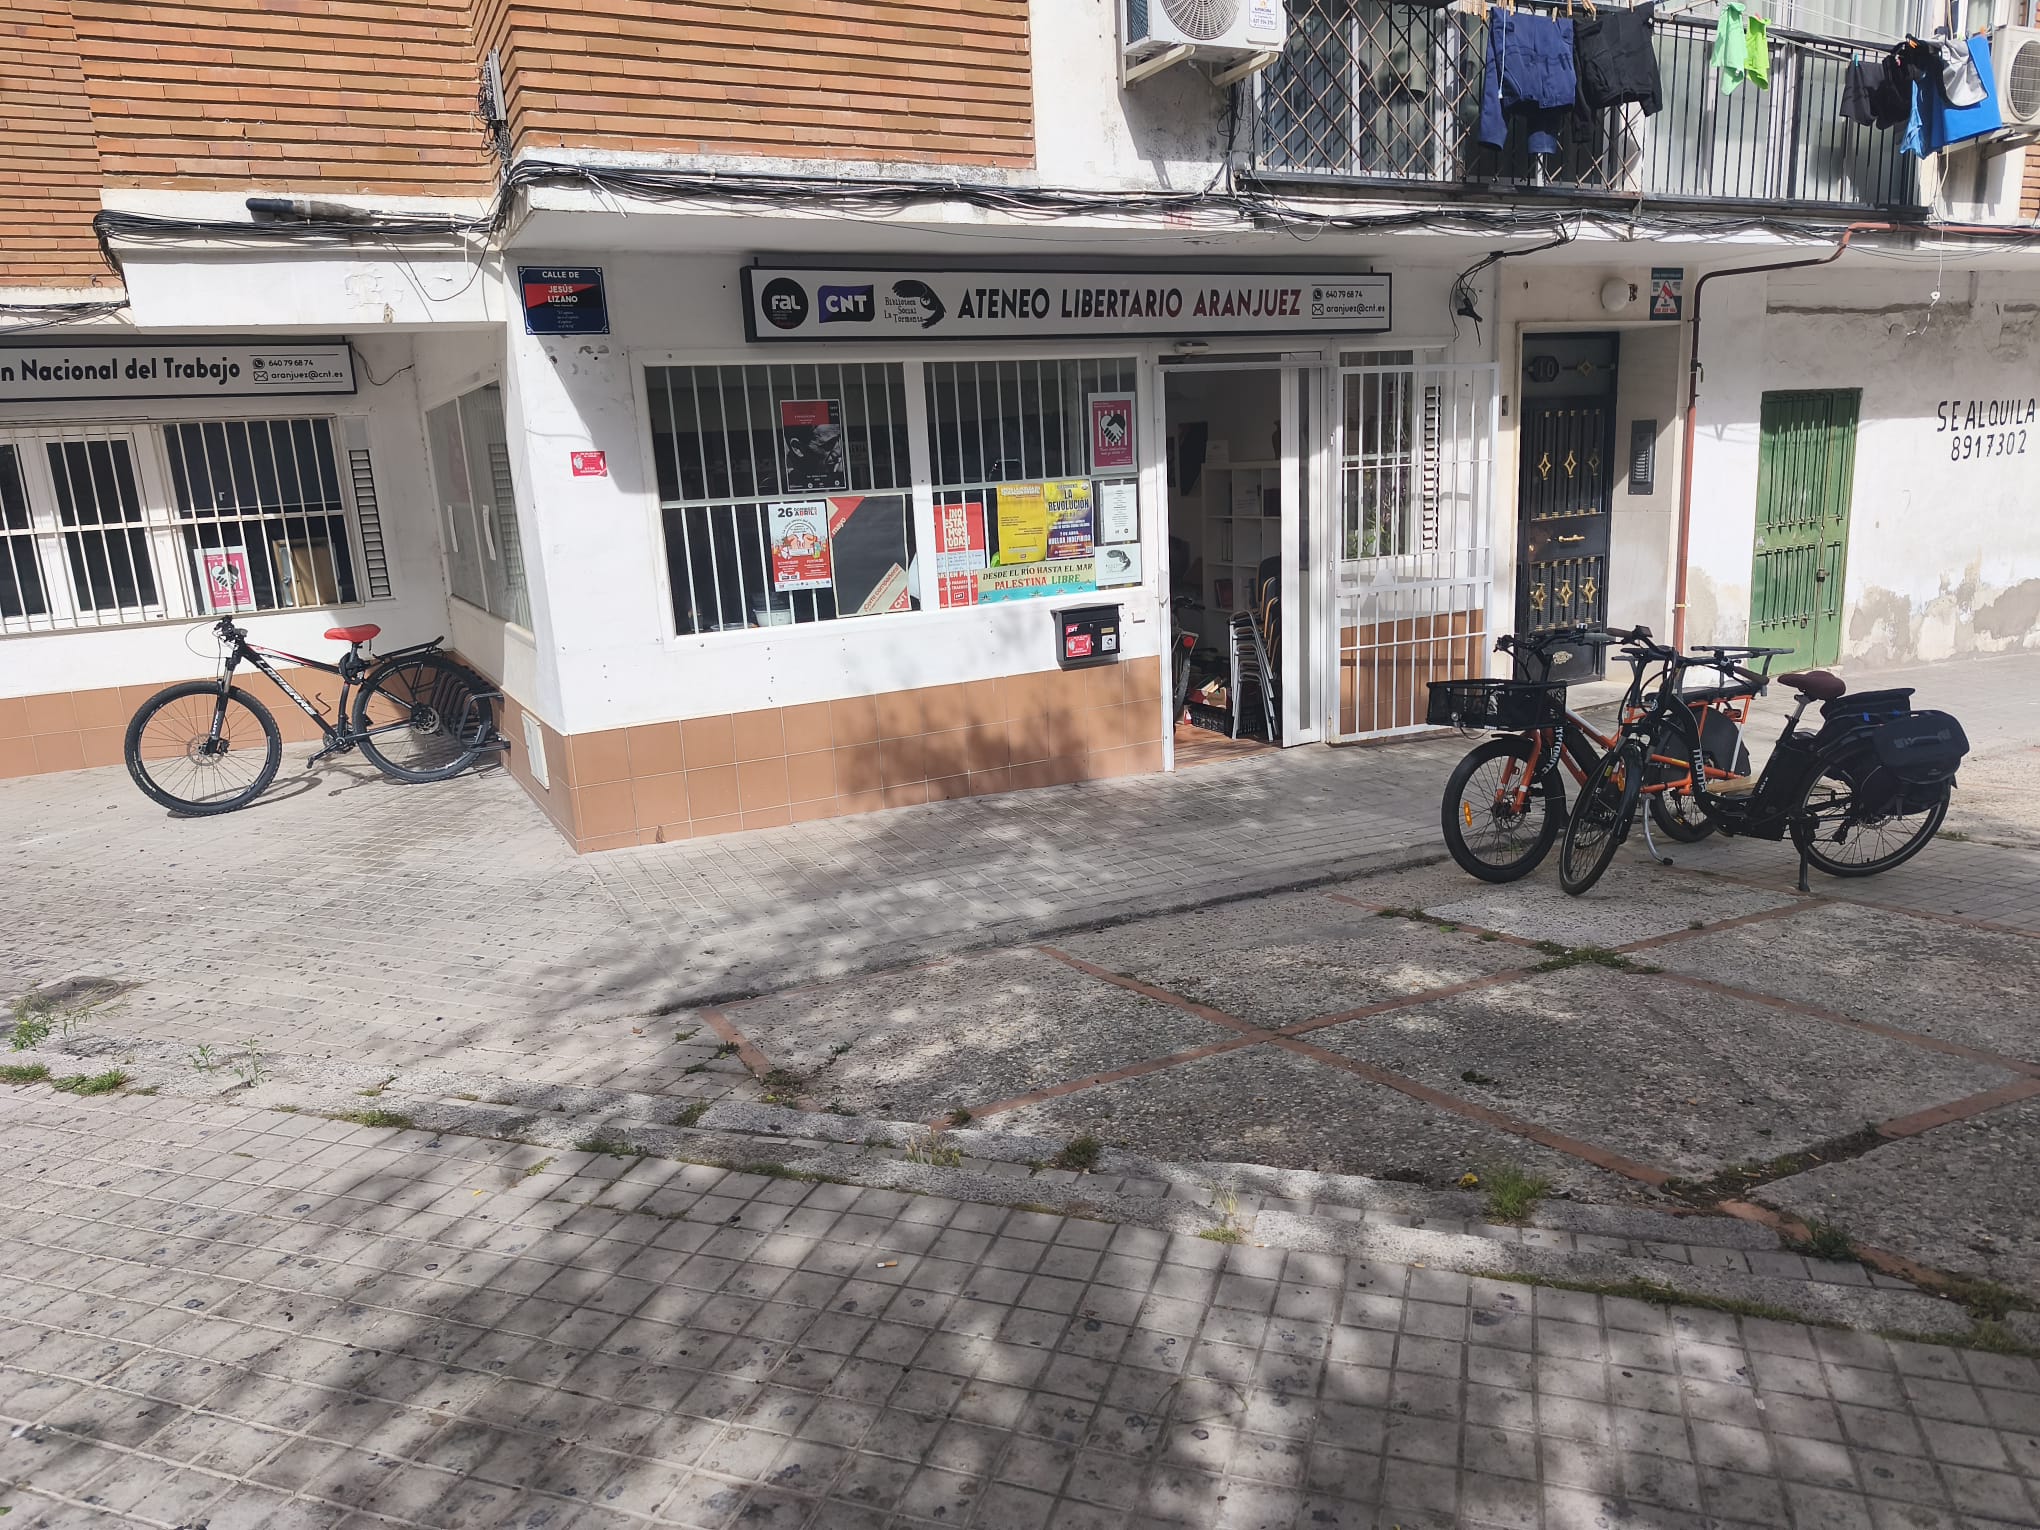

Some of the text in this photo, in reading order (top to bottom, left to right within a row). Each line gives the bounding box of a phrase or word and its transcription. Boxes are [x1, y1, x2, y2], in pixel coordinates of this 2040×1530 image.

[542, 271, 580, 279] CALLE DE
[548, 284, 573, 293] JESÚS
[547, 295, 578, 303] LIZANO
[825, 295, 867, 313] CNT
[885, 297, 917, 306] Biblioteca
[957, 288, 1301, 319] ATENEO LIBERTARIO ARANJUEZ
[1326, 303, 1385, 315] aranjuez@cnt.es
[884, 311, 924, 323] La Tormenta
[268, 359, 283, 367] 640
[284, 359, 293, 367] 79
[304, 359, 314, 367] 74
[21, 359, 118, 381] Nacional
[125, 357, 157, 380] del
[163, 357, 241, 385] Trabajo
[271, 370, 343, 381] aranjuez@cnt.es
[1937, 397, 2036, 432] SE ALQUILA
[1951, 429, 2027, 461] 8917302
[1064, 489, 1073, 500] LA
[1048, 497, 1089, 511] REVOLUCIÓN
[777, 507, 794, 518] 26
[831, 517, 847, 535] mayo
[982, 571, 1008, 580] DESDE
[1021, 566, 1036, 576] RÍO
[1037, 565, 1063, 574] HASTA
[1064, 564, 1076, 572] EL
[1077, 563, 1093, 571] MAR
[994, 574, 1080, 590] PALESTINA LIBRE
[894, 592, 908, 609] CNT
[255, 660, 319, 716] LAPIERRE
